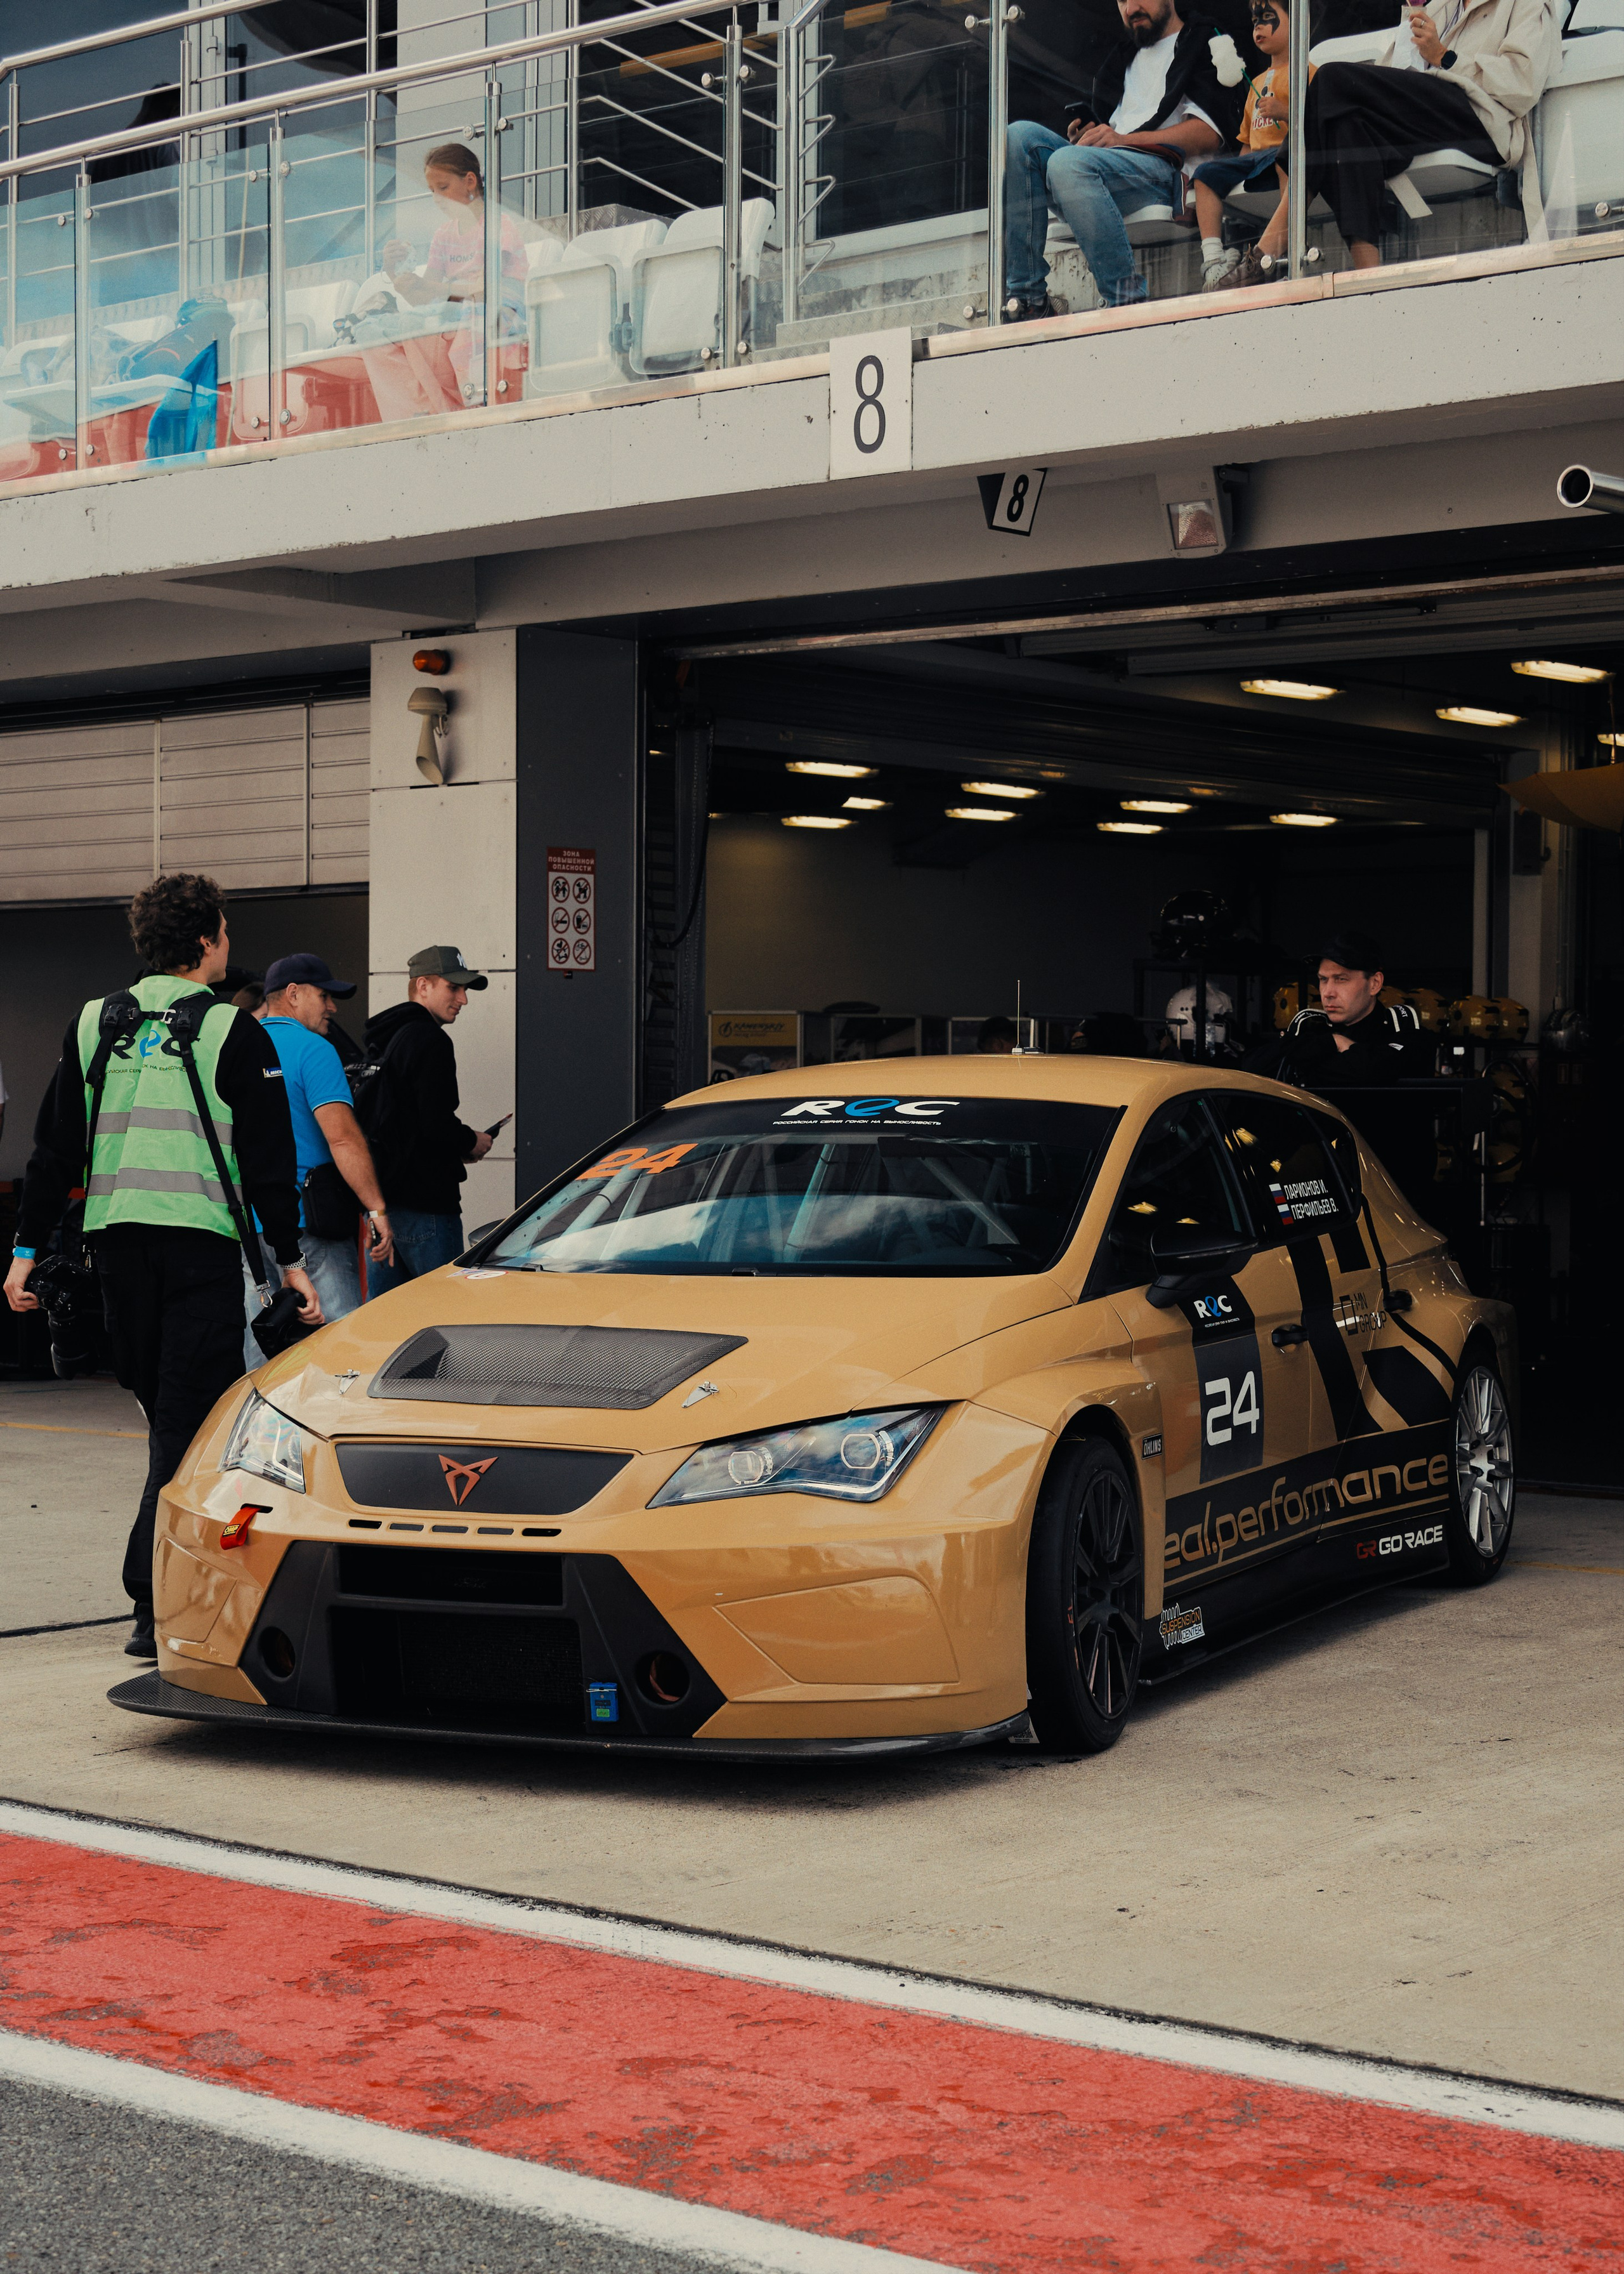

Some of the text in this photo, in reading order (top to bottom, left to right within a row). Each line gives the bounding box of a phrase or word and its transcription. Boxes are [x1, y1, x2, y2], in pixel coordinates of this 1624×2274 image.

[854, 355, 886, 454] 8
[1007, 474, 1029, 522] 8
[548, 856, 594, 865] ПОВЫШЕННОЙ
[575, 1143, 698, 1180] 24
[1283, 1179, 1328, 1200] ЛАРИОНОВ И.
[1290, 1198, 1339, 1219] ПЕРФИЛЬЕВ В.
[1354, 1292, 1368, 1310] MN
[1359, 1310, 1387, 1332] GROUP
[1205, 1370, 1259, 1446] 24
[1143, 1438, 1162, 1456] ÖHLINS
[1356, 1525, 1443, 1559] GR GO RACE
[1162, 1610, 1200, 1634] SUSPENSION
[1182, 1624, 1202, 1640] CENTER
